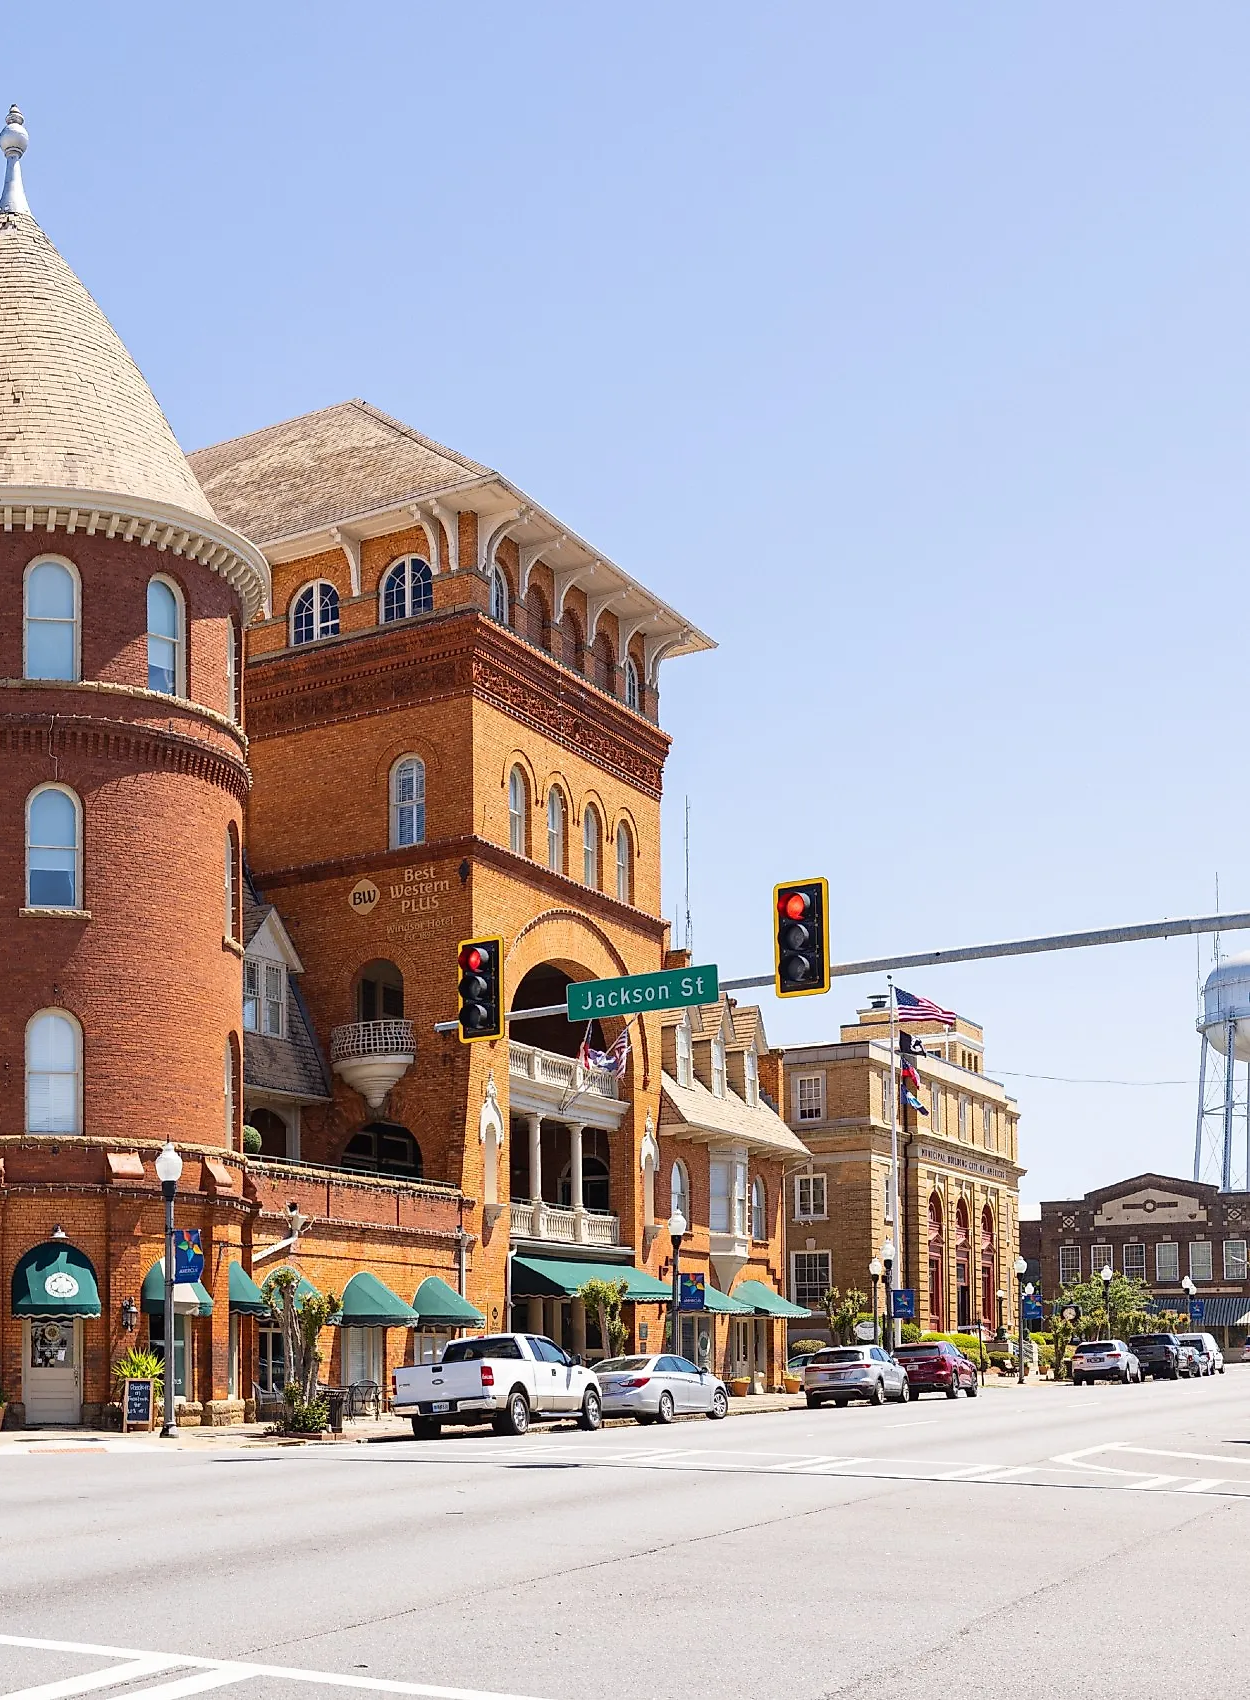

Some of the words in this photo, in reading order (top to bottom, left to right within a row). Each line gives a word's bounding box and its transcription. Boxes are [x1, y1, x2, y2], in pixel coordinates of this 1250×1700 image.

[403, 866, 436, 882] Best
[352, 889, 377, 906] BW
[390, 880, 450, 899] Western
[401, 895, 439, 914] PLUS
[386, 920, 424, 934] Windsor
[427, 916, 454, 930] Hotel
[581, 985, 669, 1010] Jackson
[680, 977, 705, 997] St
[921, 1148, 946, 1162] MUNICIPAL
[947, 1155, 968, 1168] BUILDING
